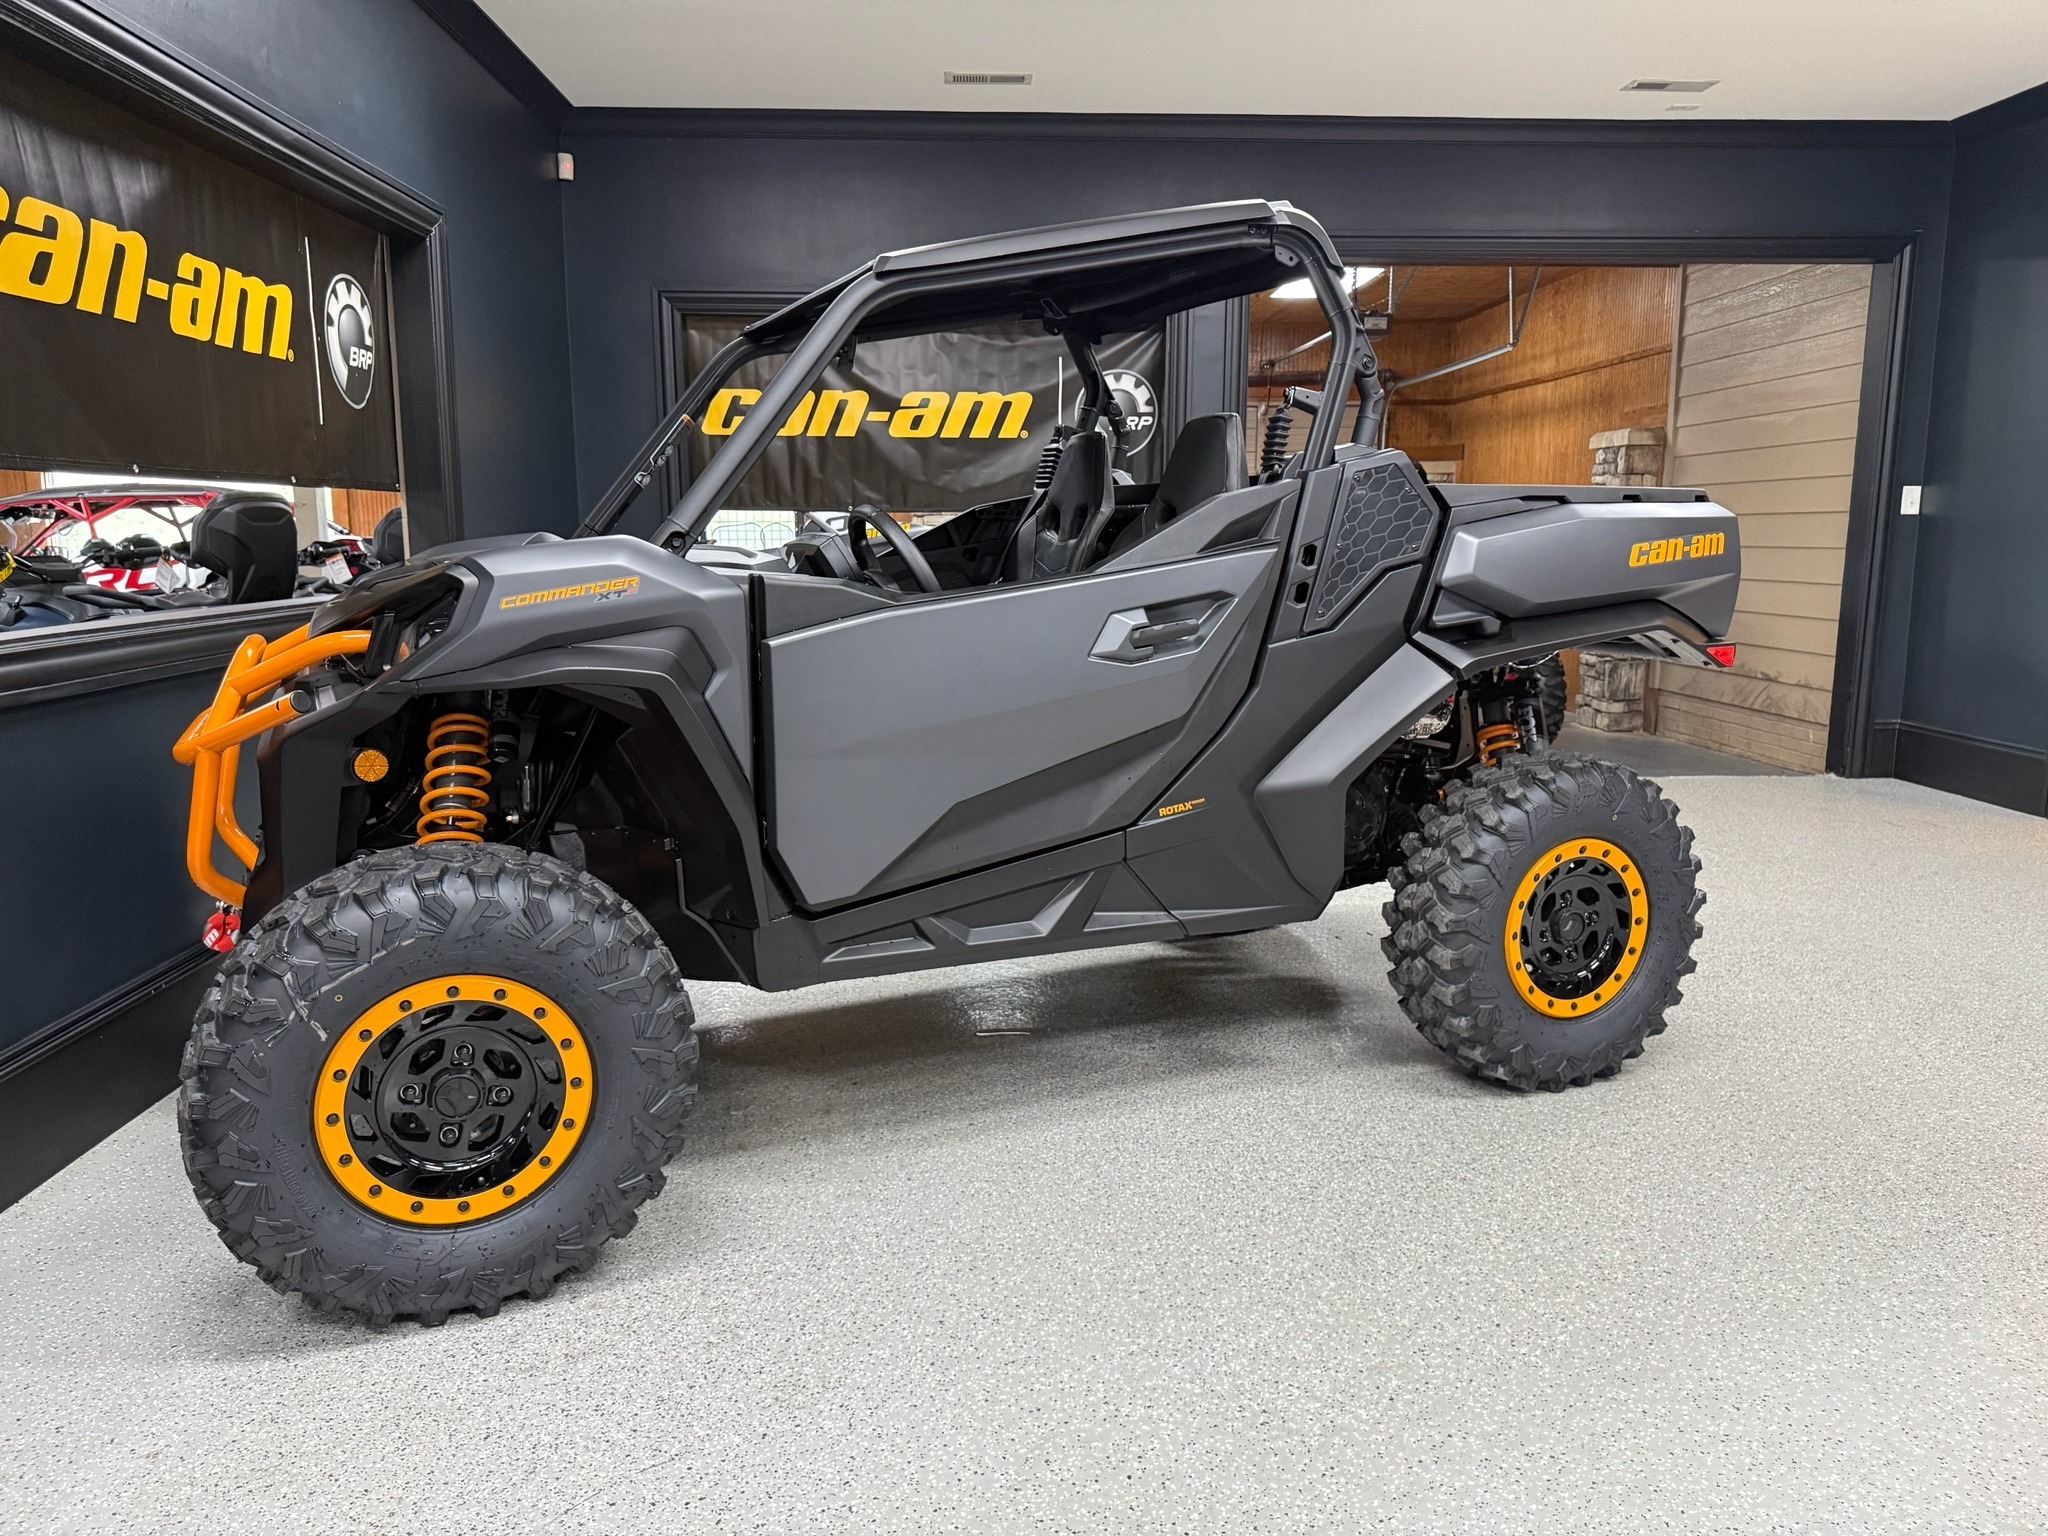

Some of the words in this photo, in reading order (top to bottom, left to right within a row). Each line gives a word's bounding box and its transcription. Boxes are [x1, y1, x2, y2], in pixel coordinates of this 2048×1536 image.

[0, 186, 293, 360] an-am
[350, 346, 373, 370] BRP
[1109, 416, 1153, 430] RP
[1629, 532, 1725, 567] can-am
[500, 575, 639, 609] COMMANDER
[1159, 801, 1192, 817] ROTAX
